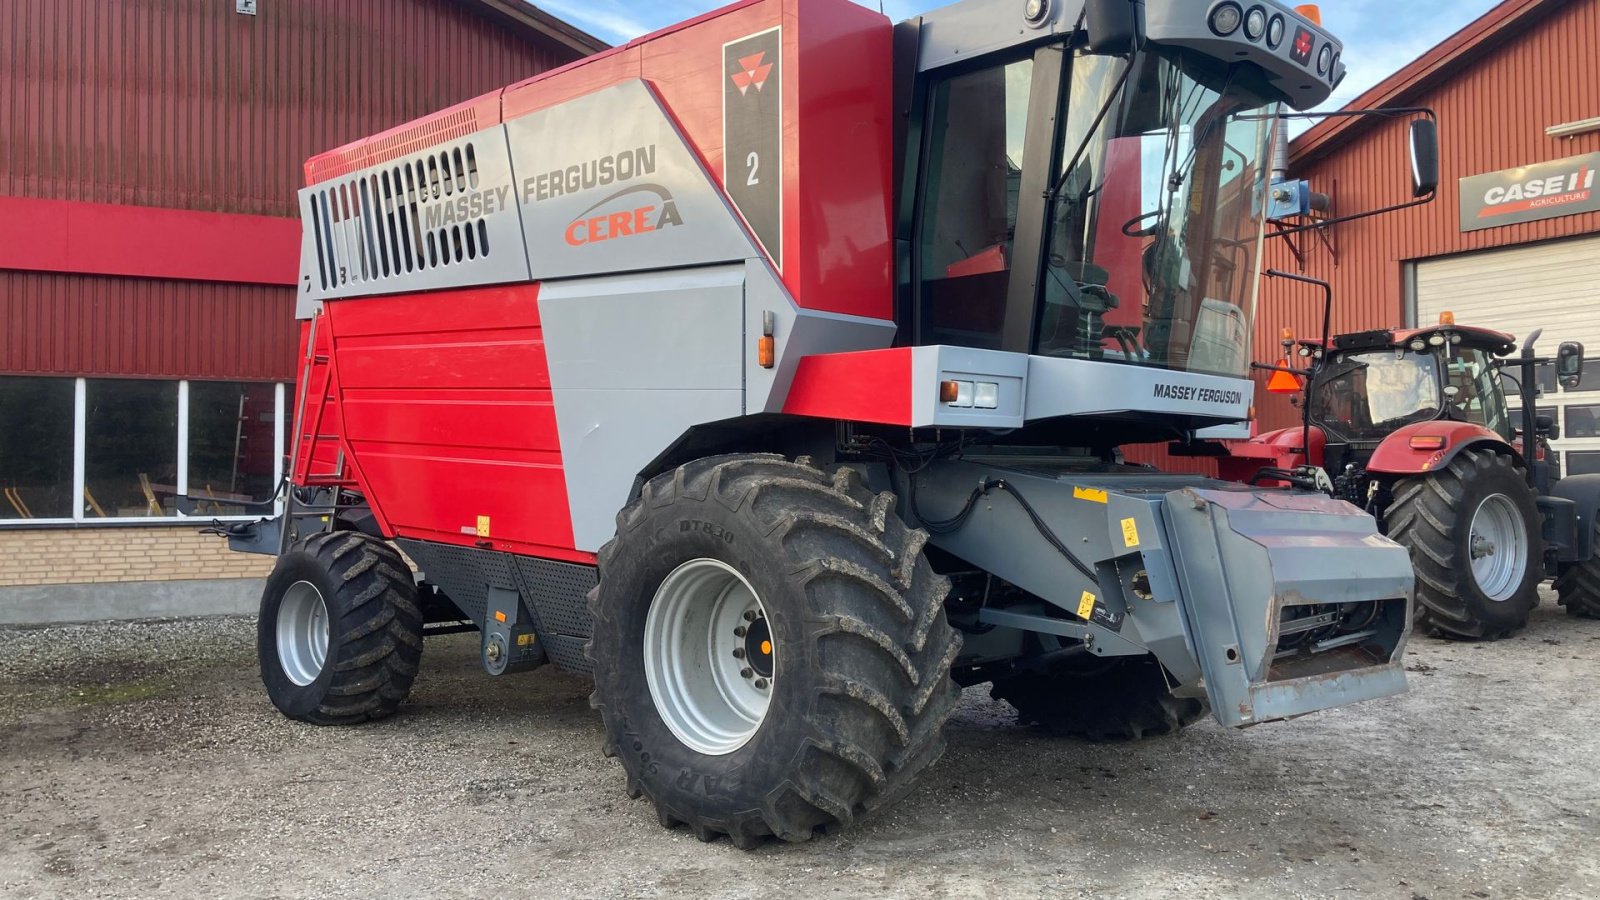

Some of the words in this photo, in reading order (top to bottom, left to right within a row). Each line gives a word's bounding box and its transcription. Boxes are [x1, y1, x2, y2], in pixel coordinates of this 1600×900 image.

[746, 151, 759, 186] 2
[425, 184, 510, 230] MASSEY
[523, 144, 656, 204] FERGUSON
[1484, 175, 1565, 205] CASE
[1529, 193, 1586, 208] AGRICULTURE
[564, 200, 684, 247] CEREA
[1153, 383, 1198, 401] MASSEY
[1197, 387, 1242, 405] FERGUSON
[680, 519, 734, 544] DT830
